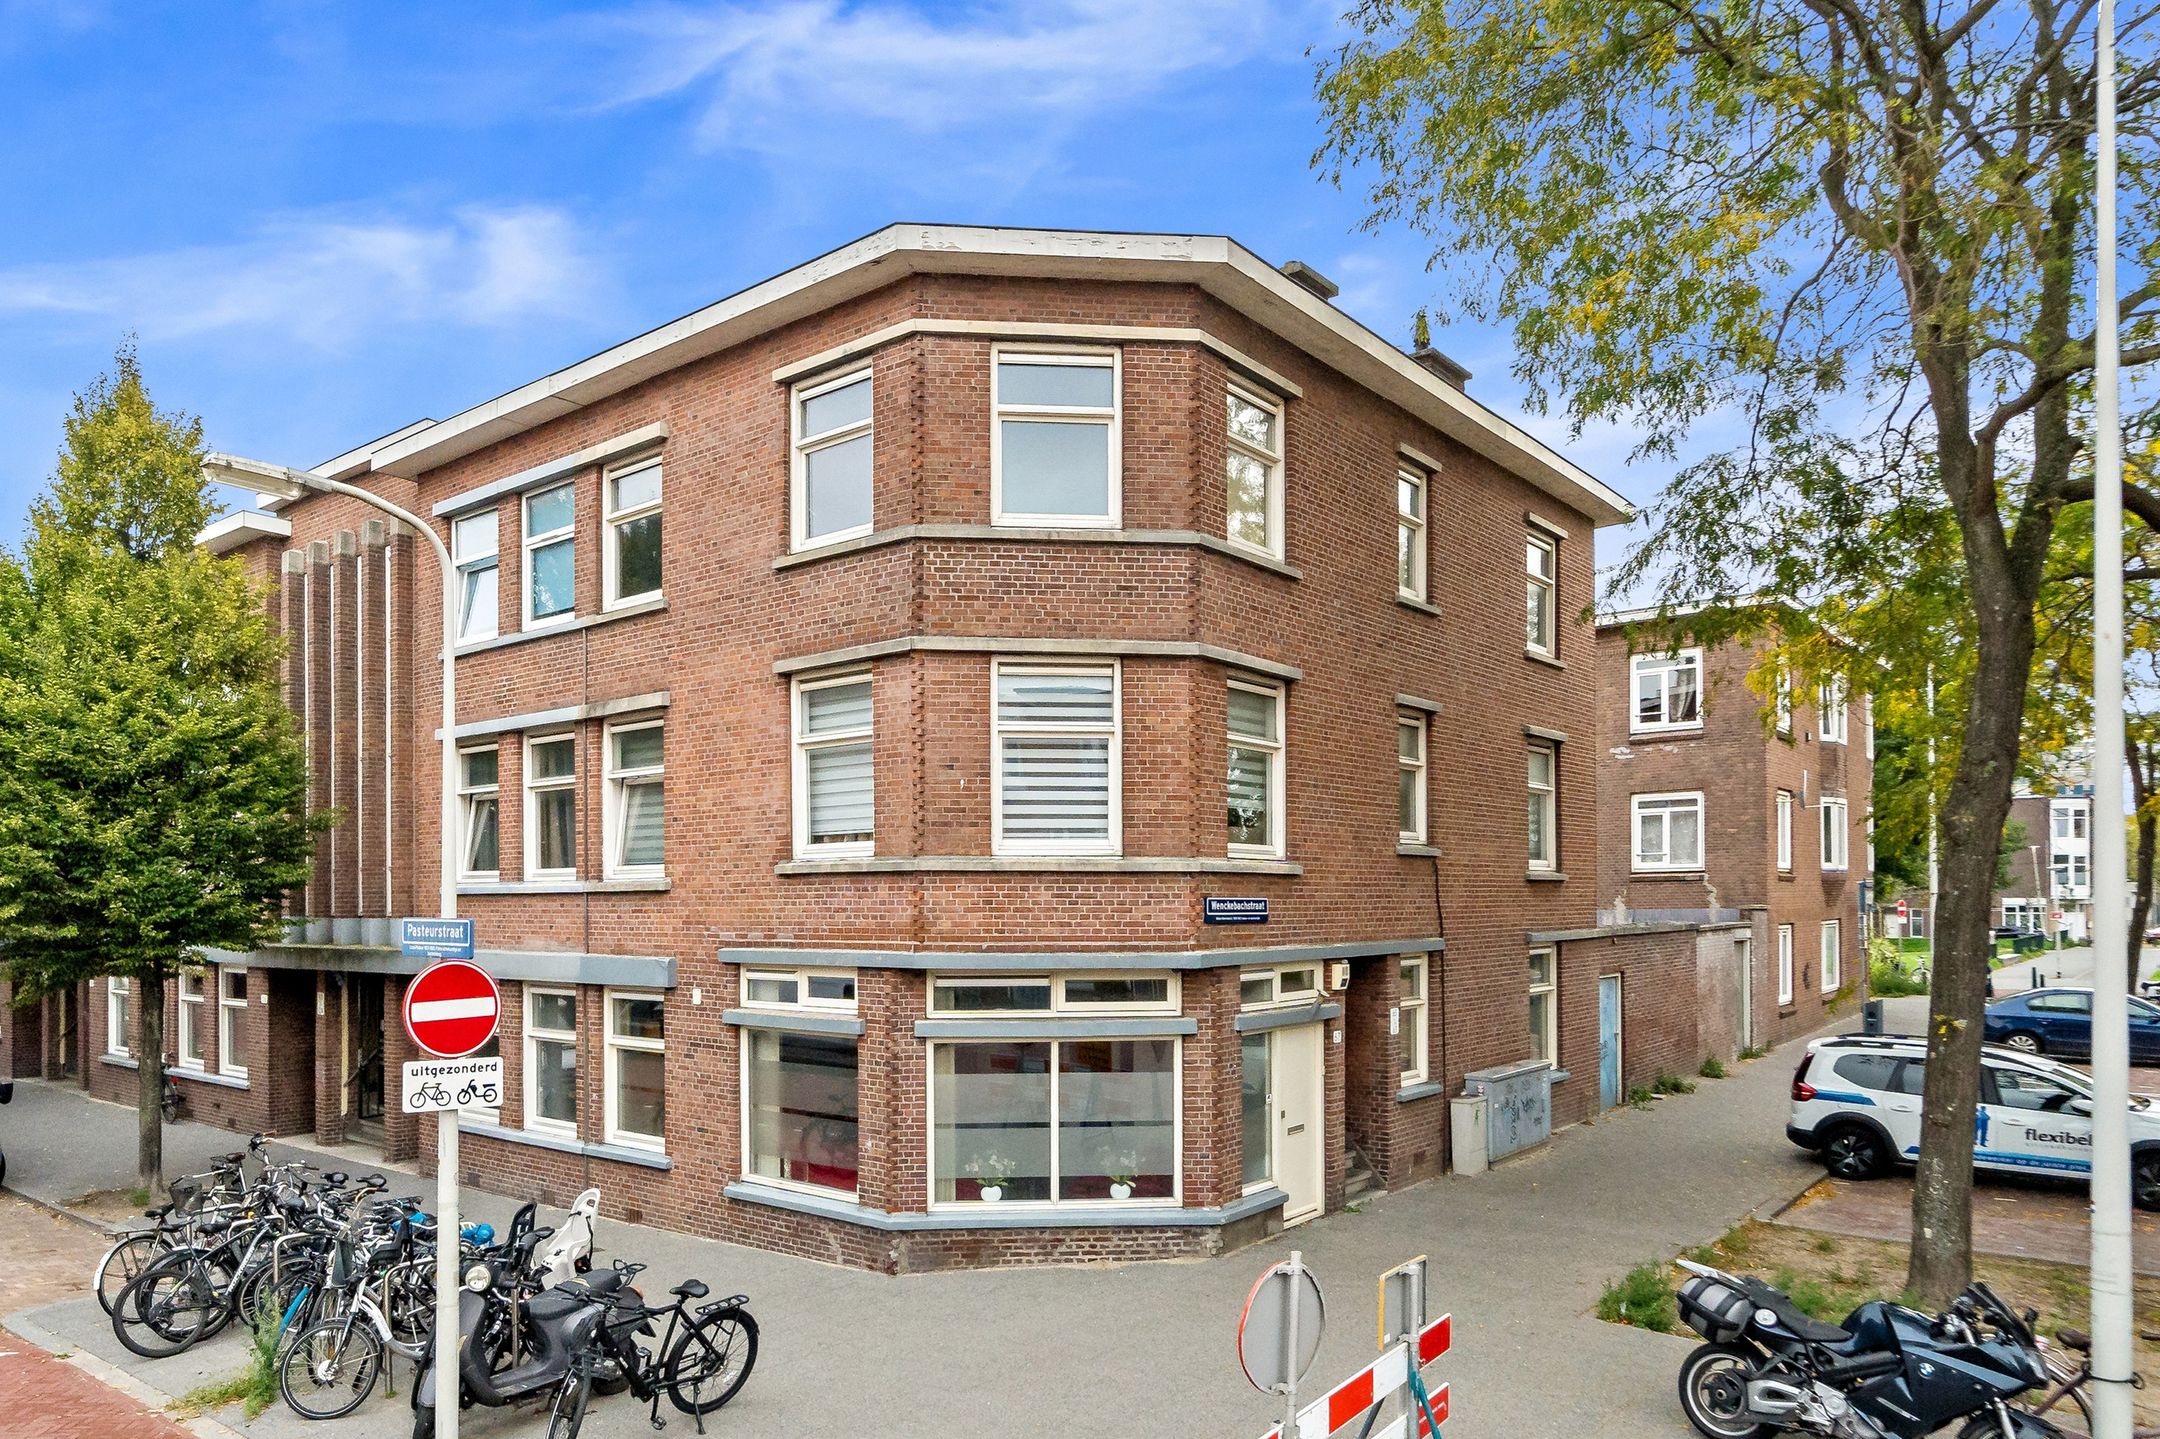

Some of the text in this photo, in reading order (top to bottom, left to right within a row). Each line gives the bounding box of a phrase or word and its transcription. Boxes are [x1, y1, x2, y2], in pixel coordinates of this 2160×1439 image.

[1210, 900, 1265, 911] Wenckebachstraat
[407, 923, 464, 938] Pasteurstraat
[411, 1062, 498, 1078] uitgezonderd
[2025, 1128, 2093, 1146] flexibel
